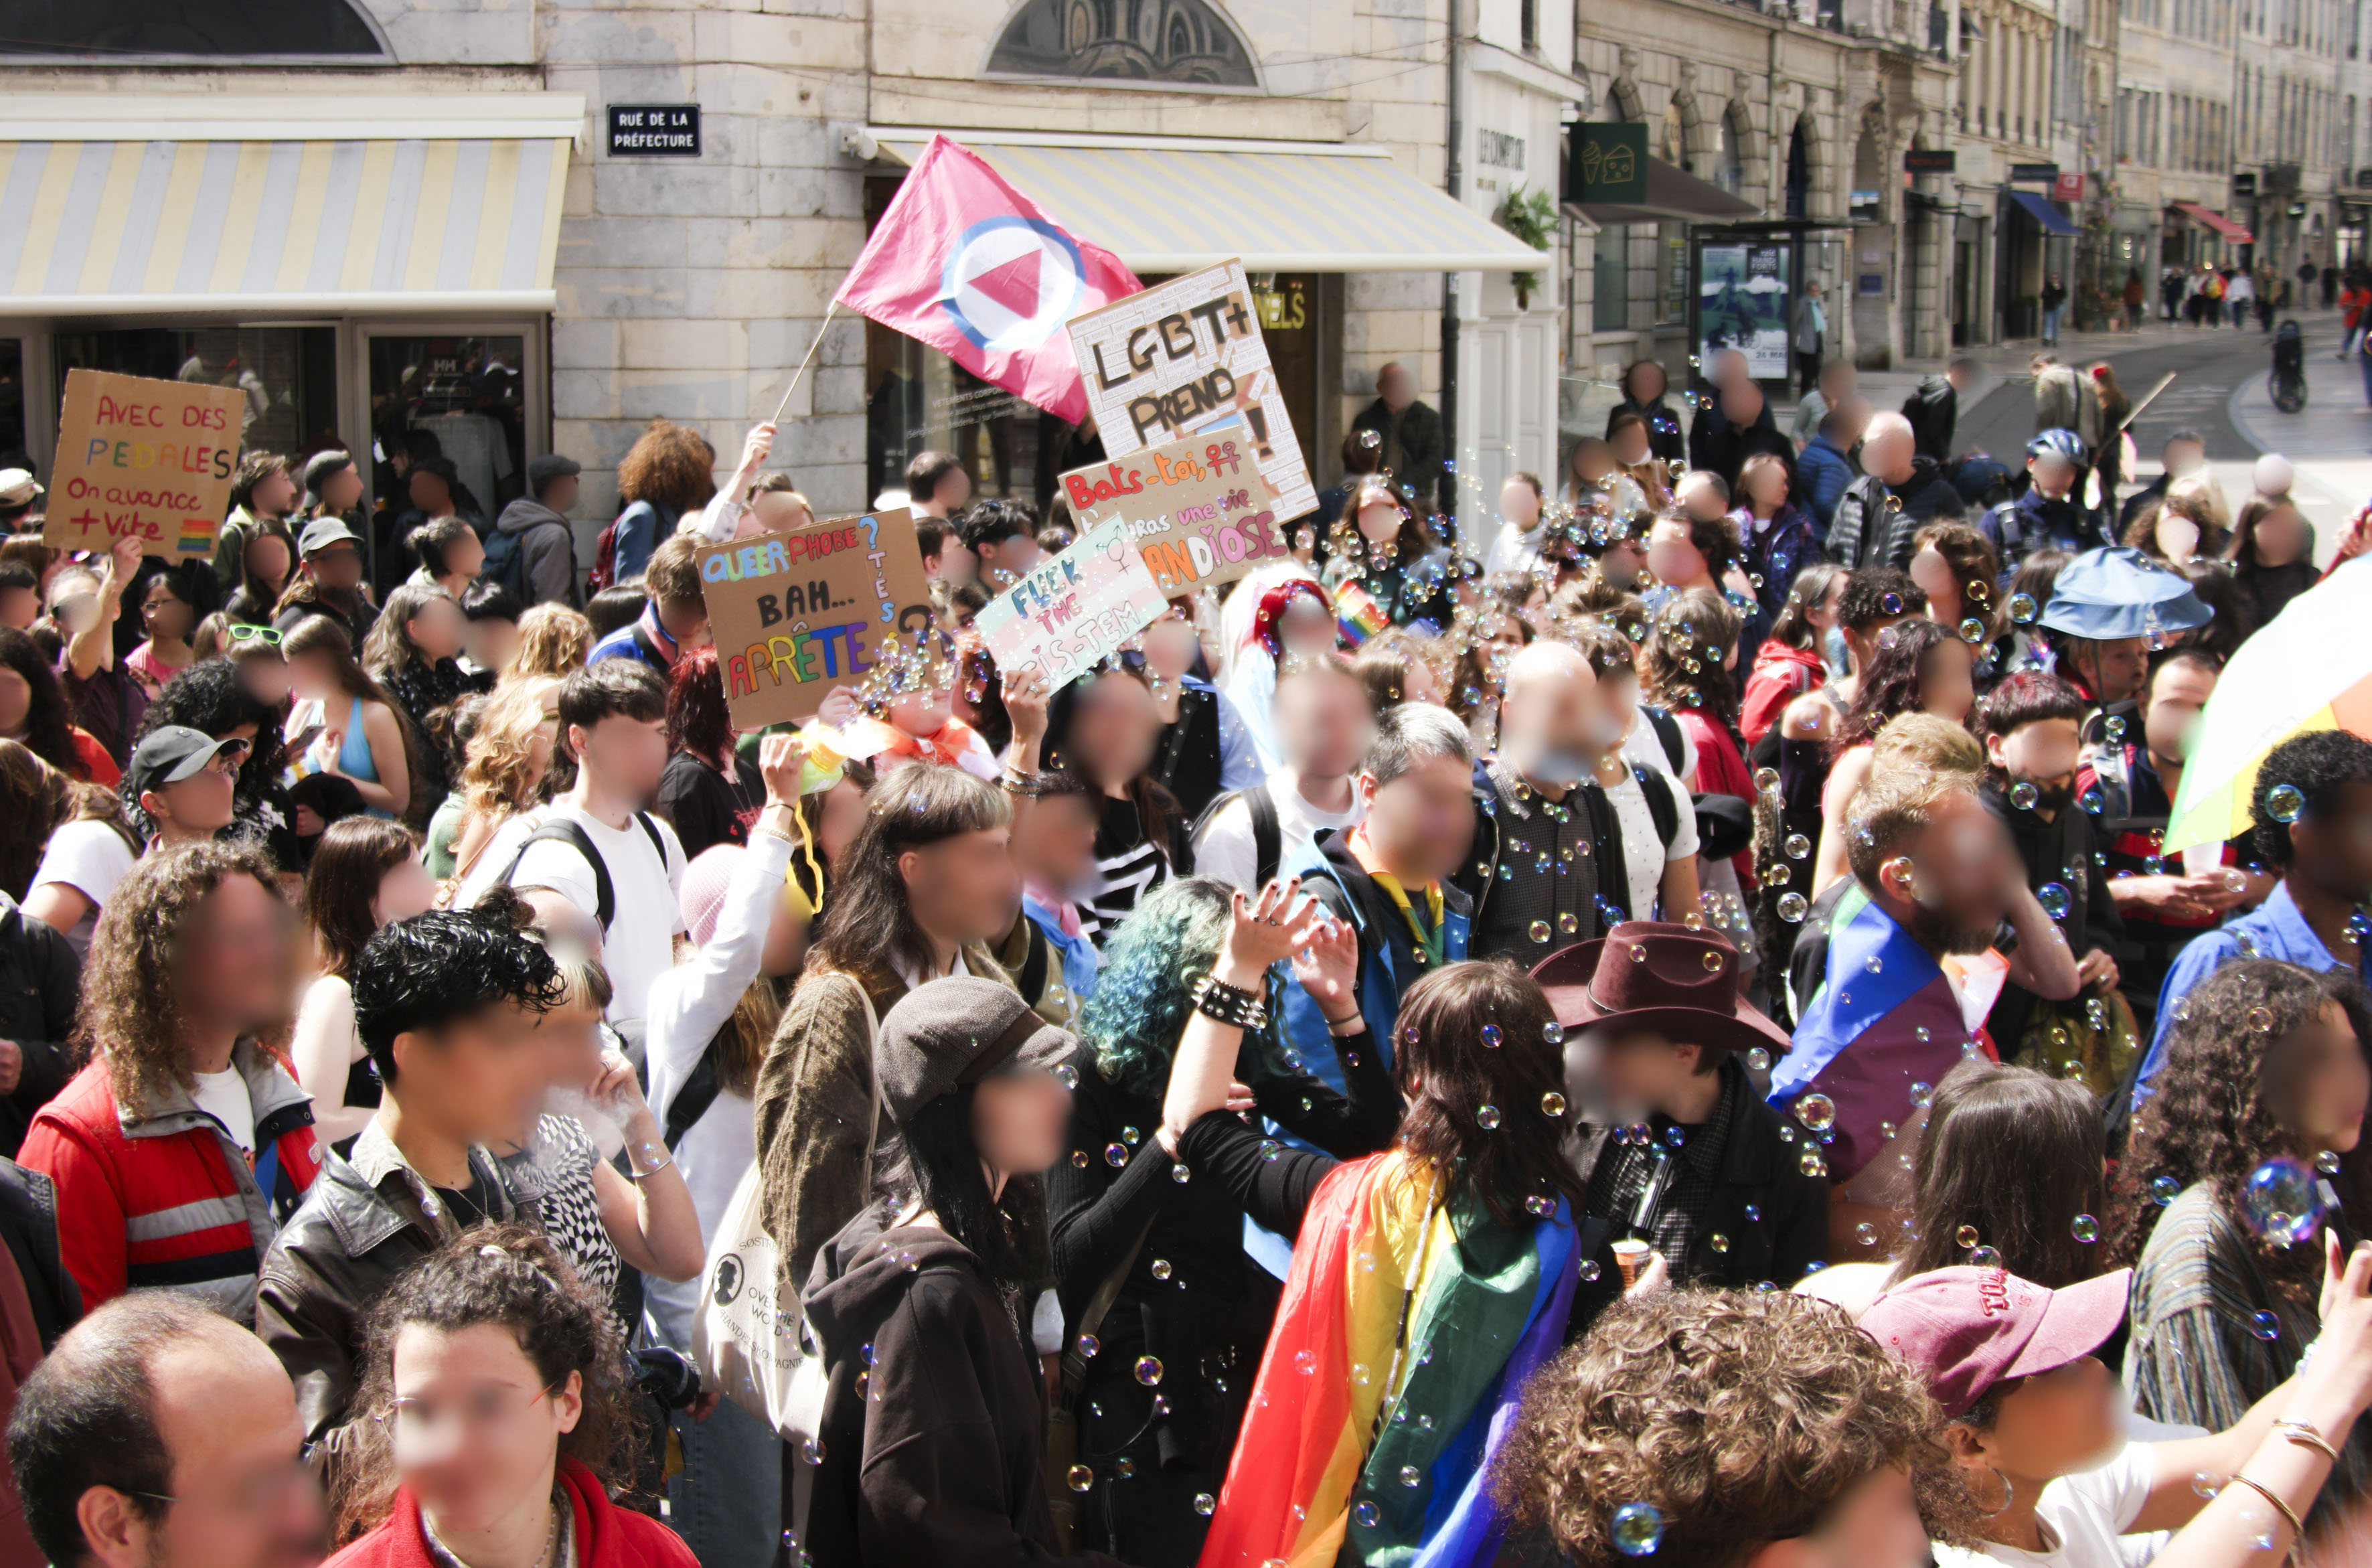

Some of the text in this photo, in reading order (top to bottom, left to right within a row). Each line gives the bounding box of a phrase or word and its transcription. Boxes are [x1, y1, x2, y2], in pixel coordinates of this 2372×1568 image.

[619, 112, 688, 126] RUE DE LA
[615, 133, 694, 147] PRÉFECTURE
[1093, 296, 1249, 390] LGBT+
[97, 395, 226, 430] AVEC DES
[86, 439, 231, 479] PEDALES
[68, 477, 202, 511] On avance
[1178, 503, 1217, 526] une
[1222, 489, 1249, 512] vie
[104, 511, 165, 541] Vite
[757, 580, 855, 628] BAH...
[1035, 593, 1083, 635] THE
[748, 1287, 772, 1309] OVE
[752, 1304, 783, 1336] WOD
